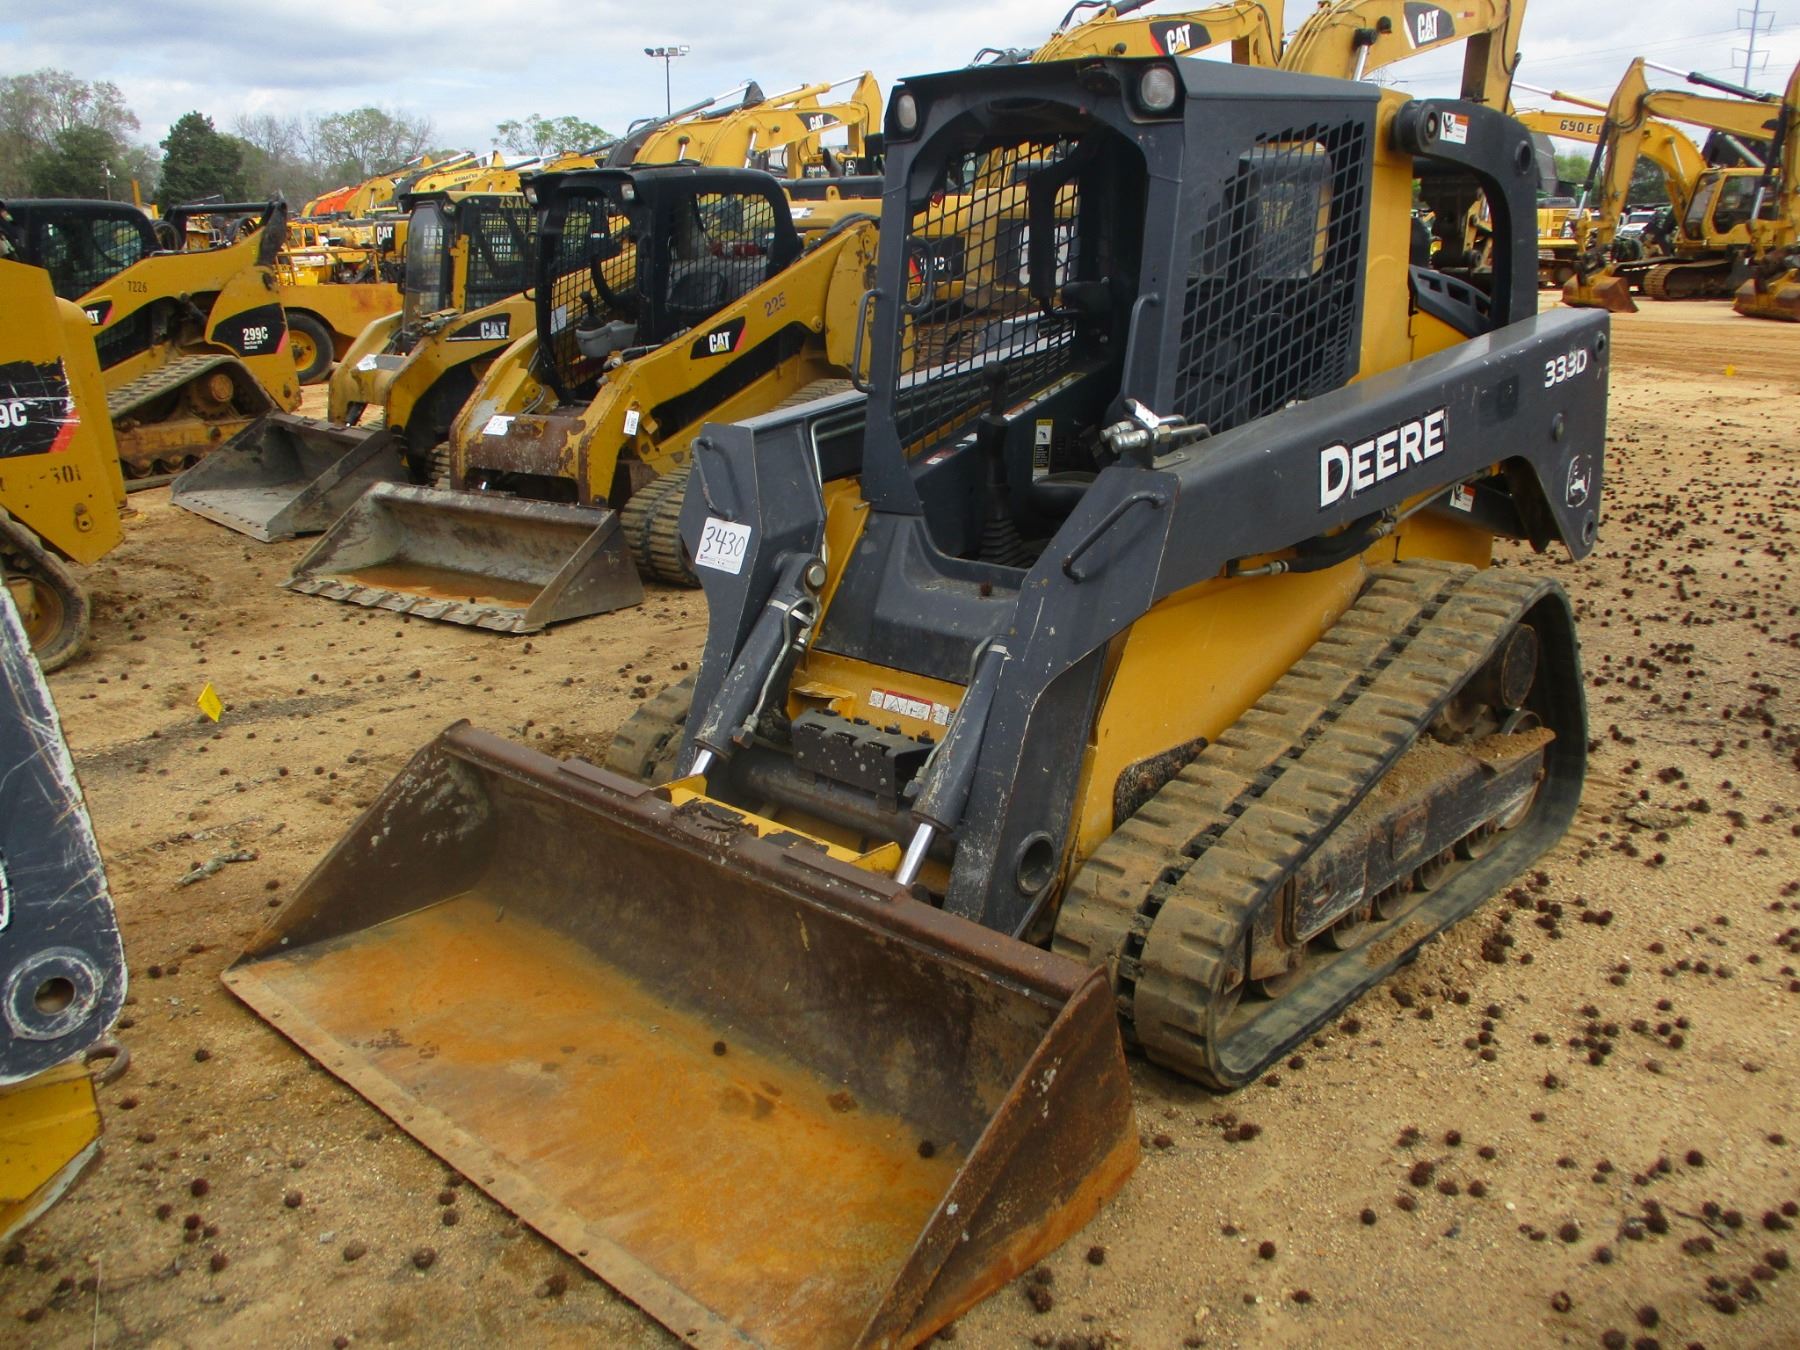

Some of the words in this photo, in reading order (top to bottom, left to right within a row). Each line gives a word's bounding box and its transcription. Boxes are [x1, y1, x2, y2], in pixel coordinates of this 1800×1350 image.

[1418, 9, 1439, 43] CAT
[1166, 23, 1191, 55] CAT
[809, 113, 824, 130] CAT
[376, 226, 393, 245] CAT
[86, 309, 99, 324] AT
[242, 326, 269, 341] 299C
[480, 321, 507, 340] CAT
[708, 331, 730, 353] CAT
[1544, 349, 1587, 388] 333D
[1320, 409, 1445, 507] DEERE
[703, 526, 746, 557] 3430
